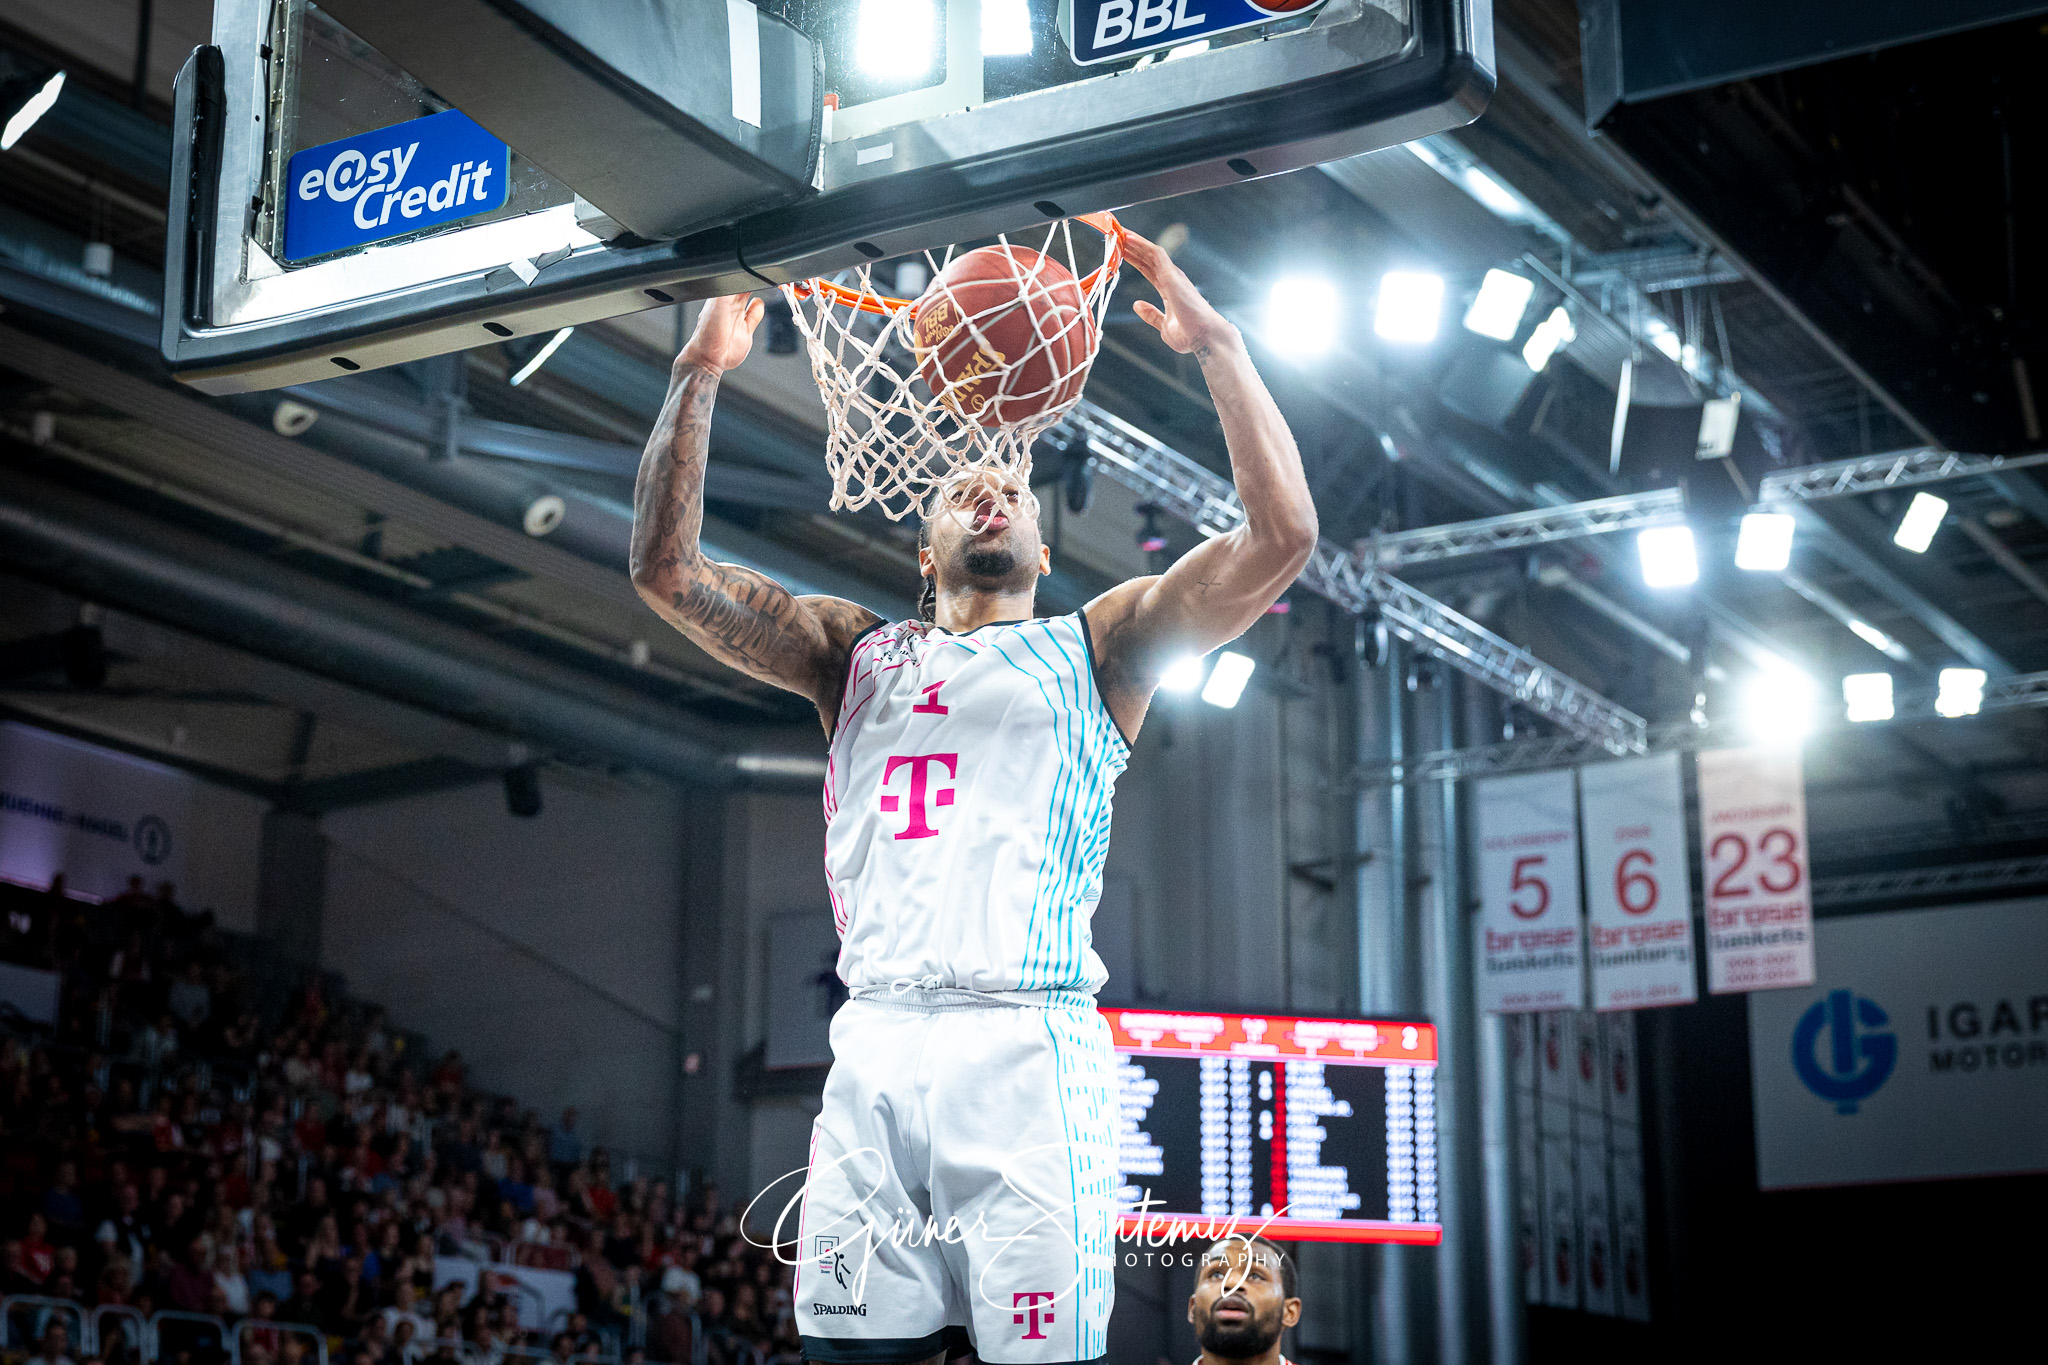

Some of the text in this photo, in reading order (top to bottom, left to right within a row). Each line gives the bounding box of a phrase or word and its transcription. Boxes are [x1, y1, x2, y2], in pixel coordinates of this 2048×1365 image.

[1092, 0, 1206, 49] BBL
[353, 160, 492, 230] Credit
[912, 679, 949, 715] 1
[1509, 853, 1551, 921] 5
[1613, 848, 1661, 917] 6
[1710, 827, 1801, 898] 23
[813, 1302, 867, 1317] SPALDING
